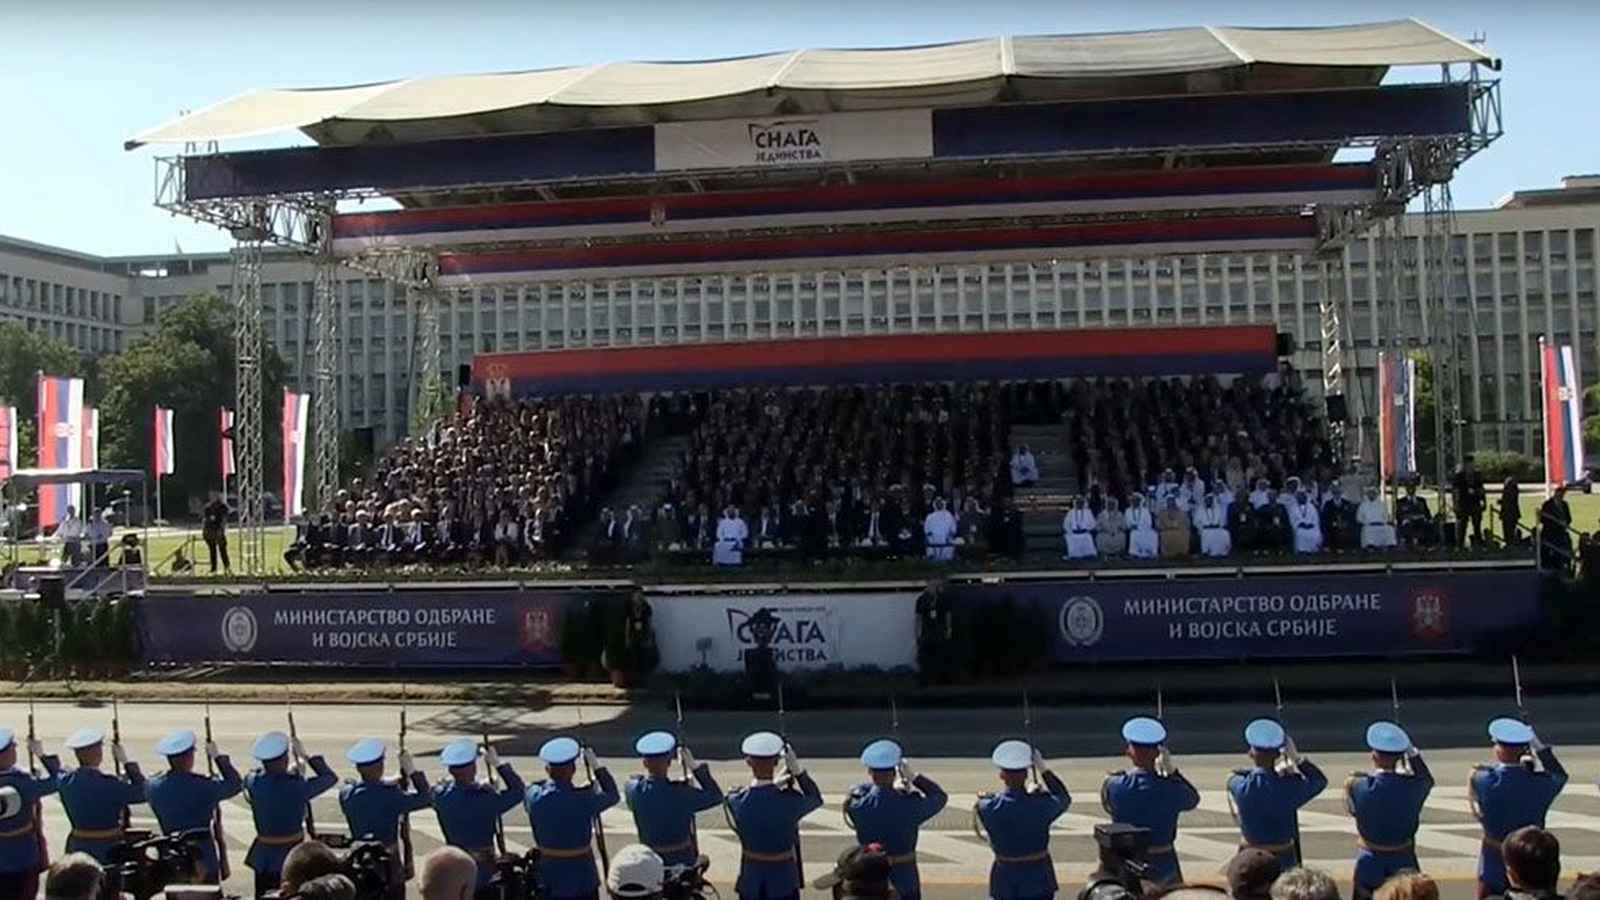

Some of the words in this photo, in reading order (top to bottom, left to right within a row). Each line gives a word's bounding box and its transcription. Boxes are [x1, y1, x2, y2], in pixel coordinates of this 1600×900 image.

[755, 129, 821, 148] СНАГА
[755, 149, 822, 162] ЈЕДИНСТВА
[1123, 596, 1284, 615] МИНИСТАРСТВО
[1290, 593, 1382, 613] ОДБРАНЕ
[274, 609, 410, 625] МИНИСТАРСТВО
[415, 608, 496, 626] ОДБРАНЕ
[737, 619, 826, 644] САГА
[1169, 623, 1182, 639] И
[1190, 621, 1261, 640] ВОЈСКА
[1267, 619, 1338, 638] СРБИЈЕ
[312, 632, 324, 647] И
[329, 631, 390, 649] ВОЈСКА
[395, 631, 457, 649] СРБИЈЕ
